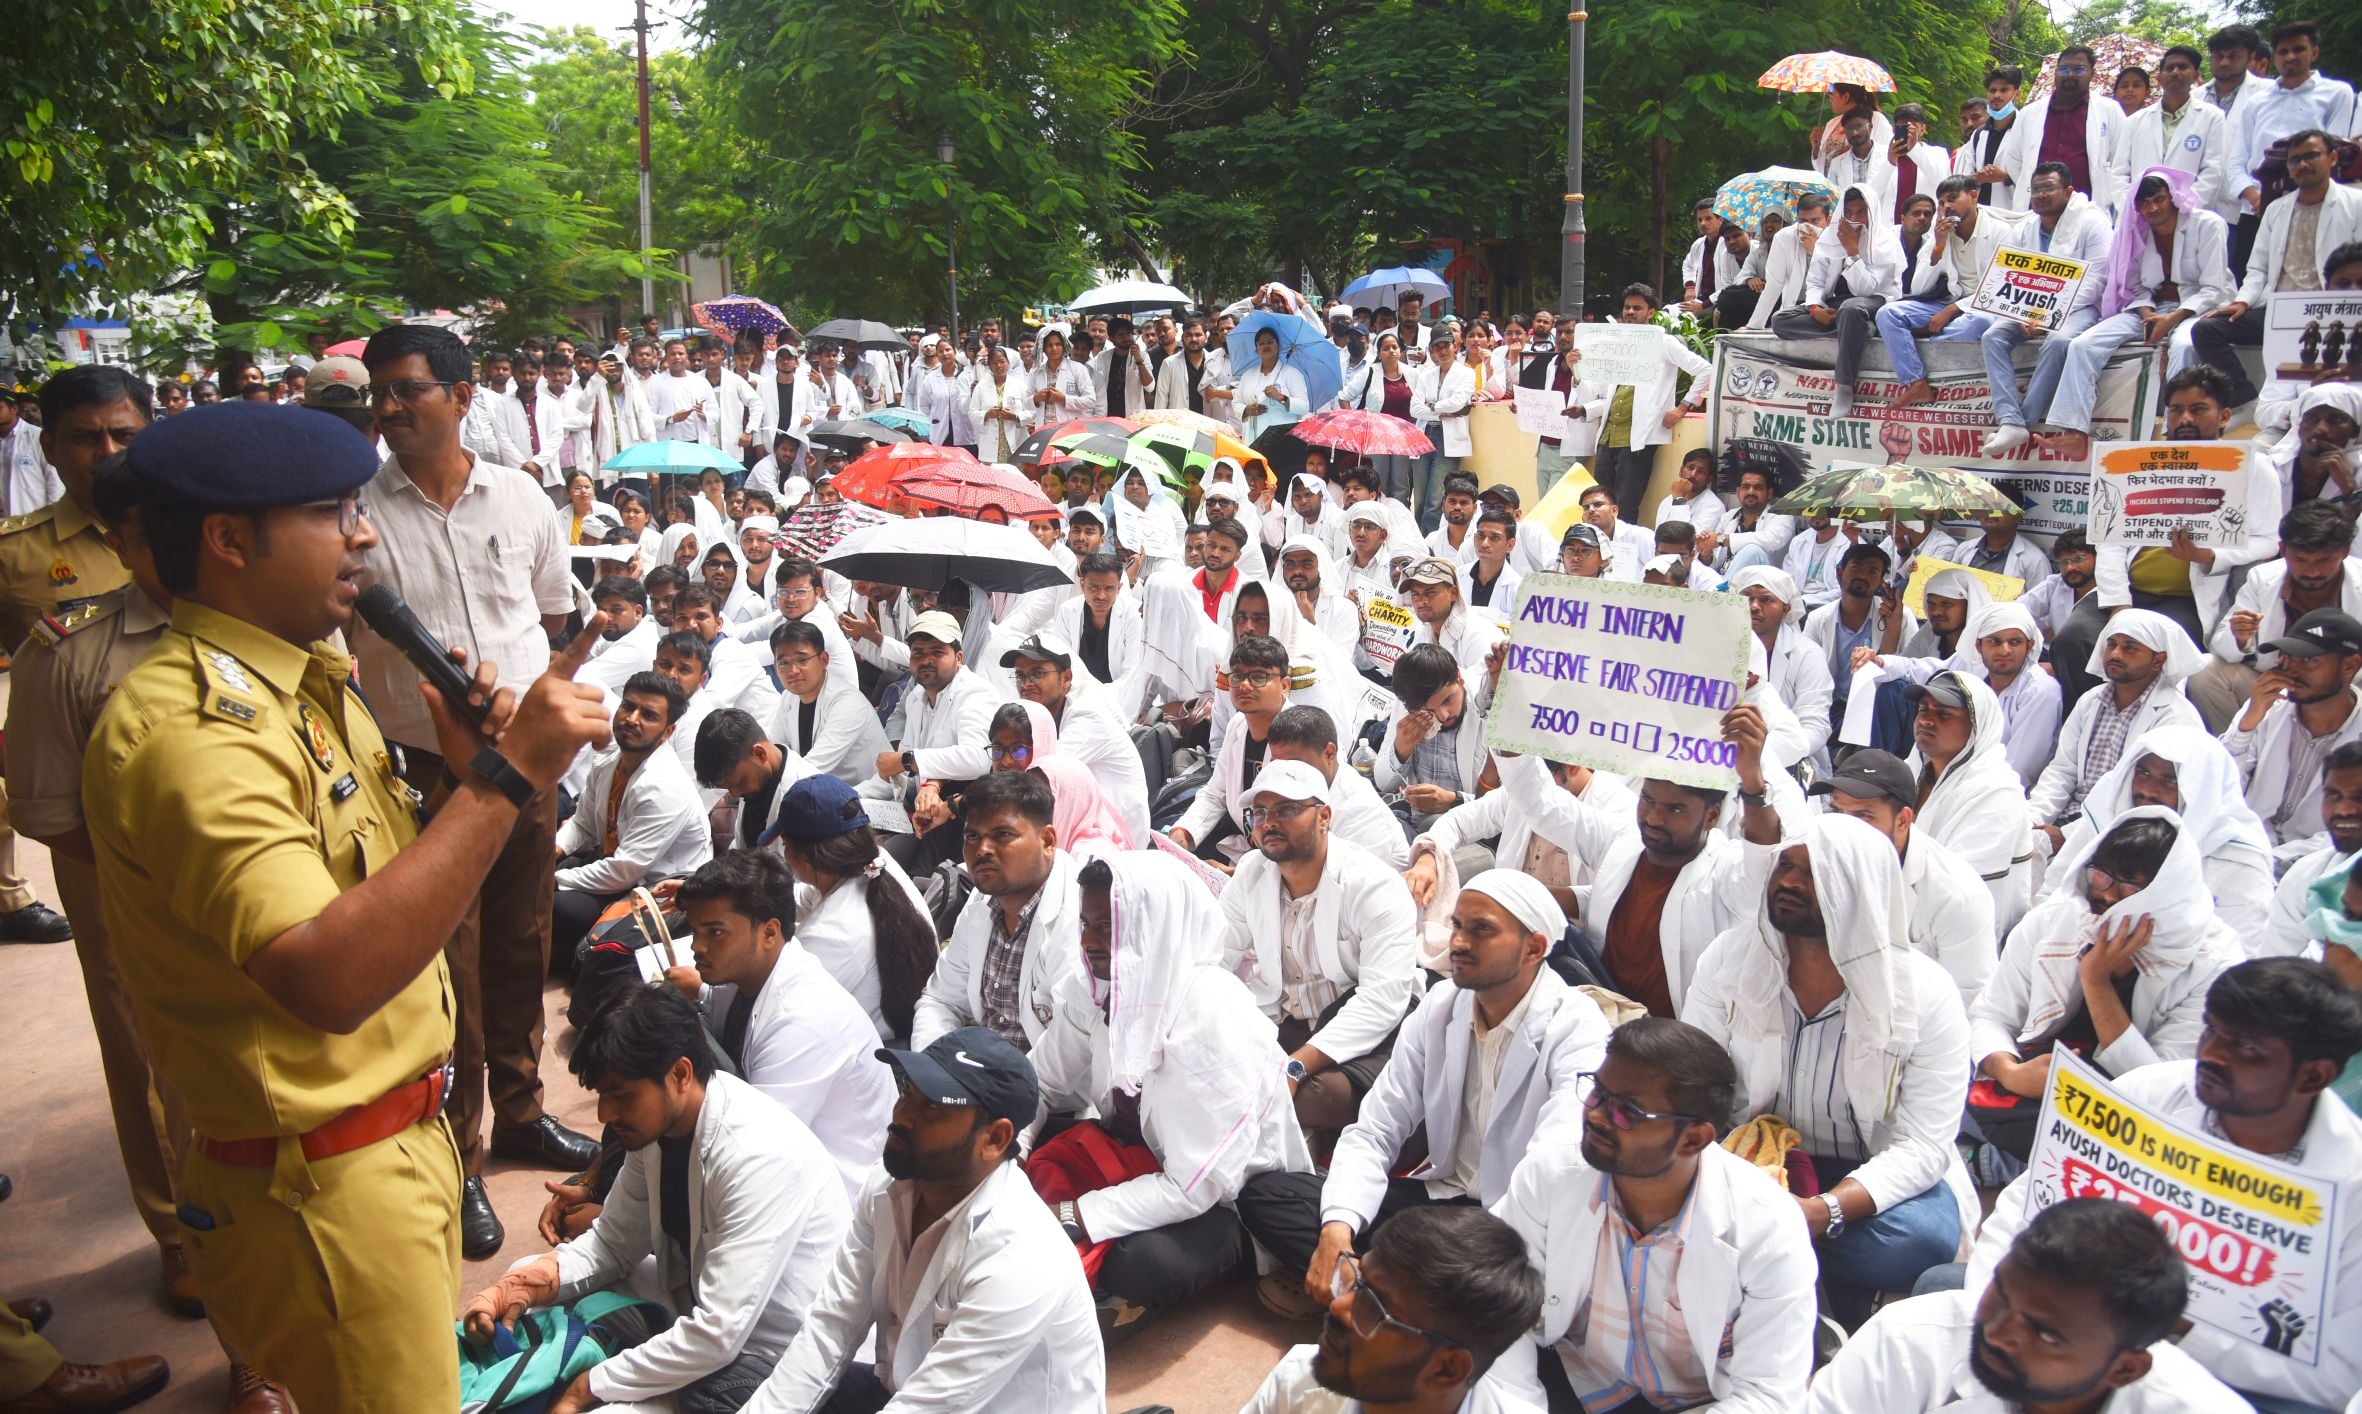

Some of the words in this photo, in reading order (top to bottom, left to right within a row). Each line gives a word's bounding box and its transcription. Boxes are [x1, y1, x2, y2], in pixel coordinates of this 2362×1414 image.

[2004, 253, 2032, 269] एक
[2033, 257, 2079, 280] आवाज
[1996, 282, 2058, 311] Ayush
[2303, 303, 2333, 320] आयुष
[2334, 299, 2362, 316] मंत्राल
[1585, 358, 1631, 370] STIPEND
[1811, 404, 1828, 415] WE
[1870, 409, 1887, 419] WE
[1890, 410, 1923, 422] CARE,
[1923, 412, 1941, 422] WE
[1945, 412, 1994, 425] DESERV
[1753, 411, 1806, 445] SAME
[1811, 418, 1873, 450] STATE
[1917, 427, 1984, 458] SAME
[2150, 450, 2168, 460] एक
[2171, 448, 2190, 461] देश
[2140, 462, 2158, 472] एक
[2161, 461, 2199, 472] स्वास्थ्य
[2127, 475, 2147, 486] फिर
[2149, 473, 2184, 486] भेदभाव
[2187, 474, 2208, 486] क्यों
[2054, 481, 2090, 496] DESE
[2052, 499, 2090, 515] ₹25,00
[2129, 498, 2158, 506] INCREASE
[2158, 497, 2185, 505] STIPEND
[2185, 497, 2194, 505] TO
[2020, 519, 2048, 528] ESPECT
[2124, 518, 2173, 527] STIPEND
[2122, 528, 2143, 539] अभी
[2146, 528, 2164, 539] और
[1374, 590, 1385, 599] We
[1374, 600, 1394, 611] asking
[1368, 606, 1410, 628] CHARITY,
[1519, 595, 1589, 630] AYUSH
[1598, 604, 1686, 644] INTERN
[1369, 620, 1397, 637] Demanding
[1508, 643, 1590, 684] DESERVE
[1600, 659, 1640, 694] FAIR
[1642, 668, 1738, 711] STIPENED
[1529, 703, 1579, 736] 7500
[1666, 732, 1737, 769] 25000
[942, 1096, 967, 1105] DRI-FIT
[2064, 1083, 2137, 1147] ₹7,500
[2140, 1132, 2156, 1157] IS
[2161, 1146, 2201, 1176] NOT
[2206, 1163, 2304, 1211] ENOUGH
[2050, 1119, 2102, 1165] AYUSH
[2105, 1151, 2194, 1210] DOCTORS
[2200, 1197, 2313, 1256] DESERVE
